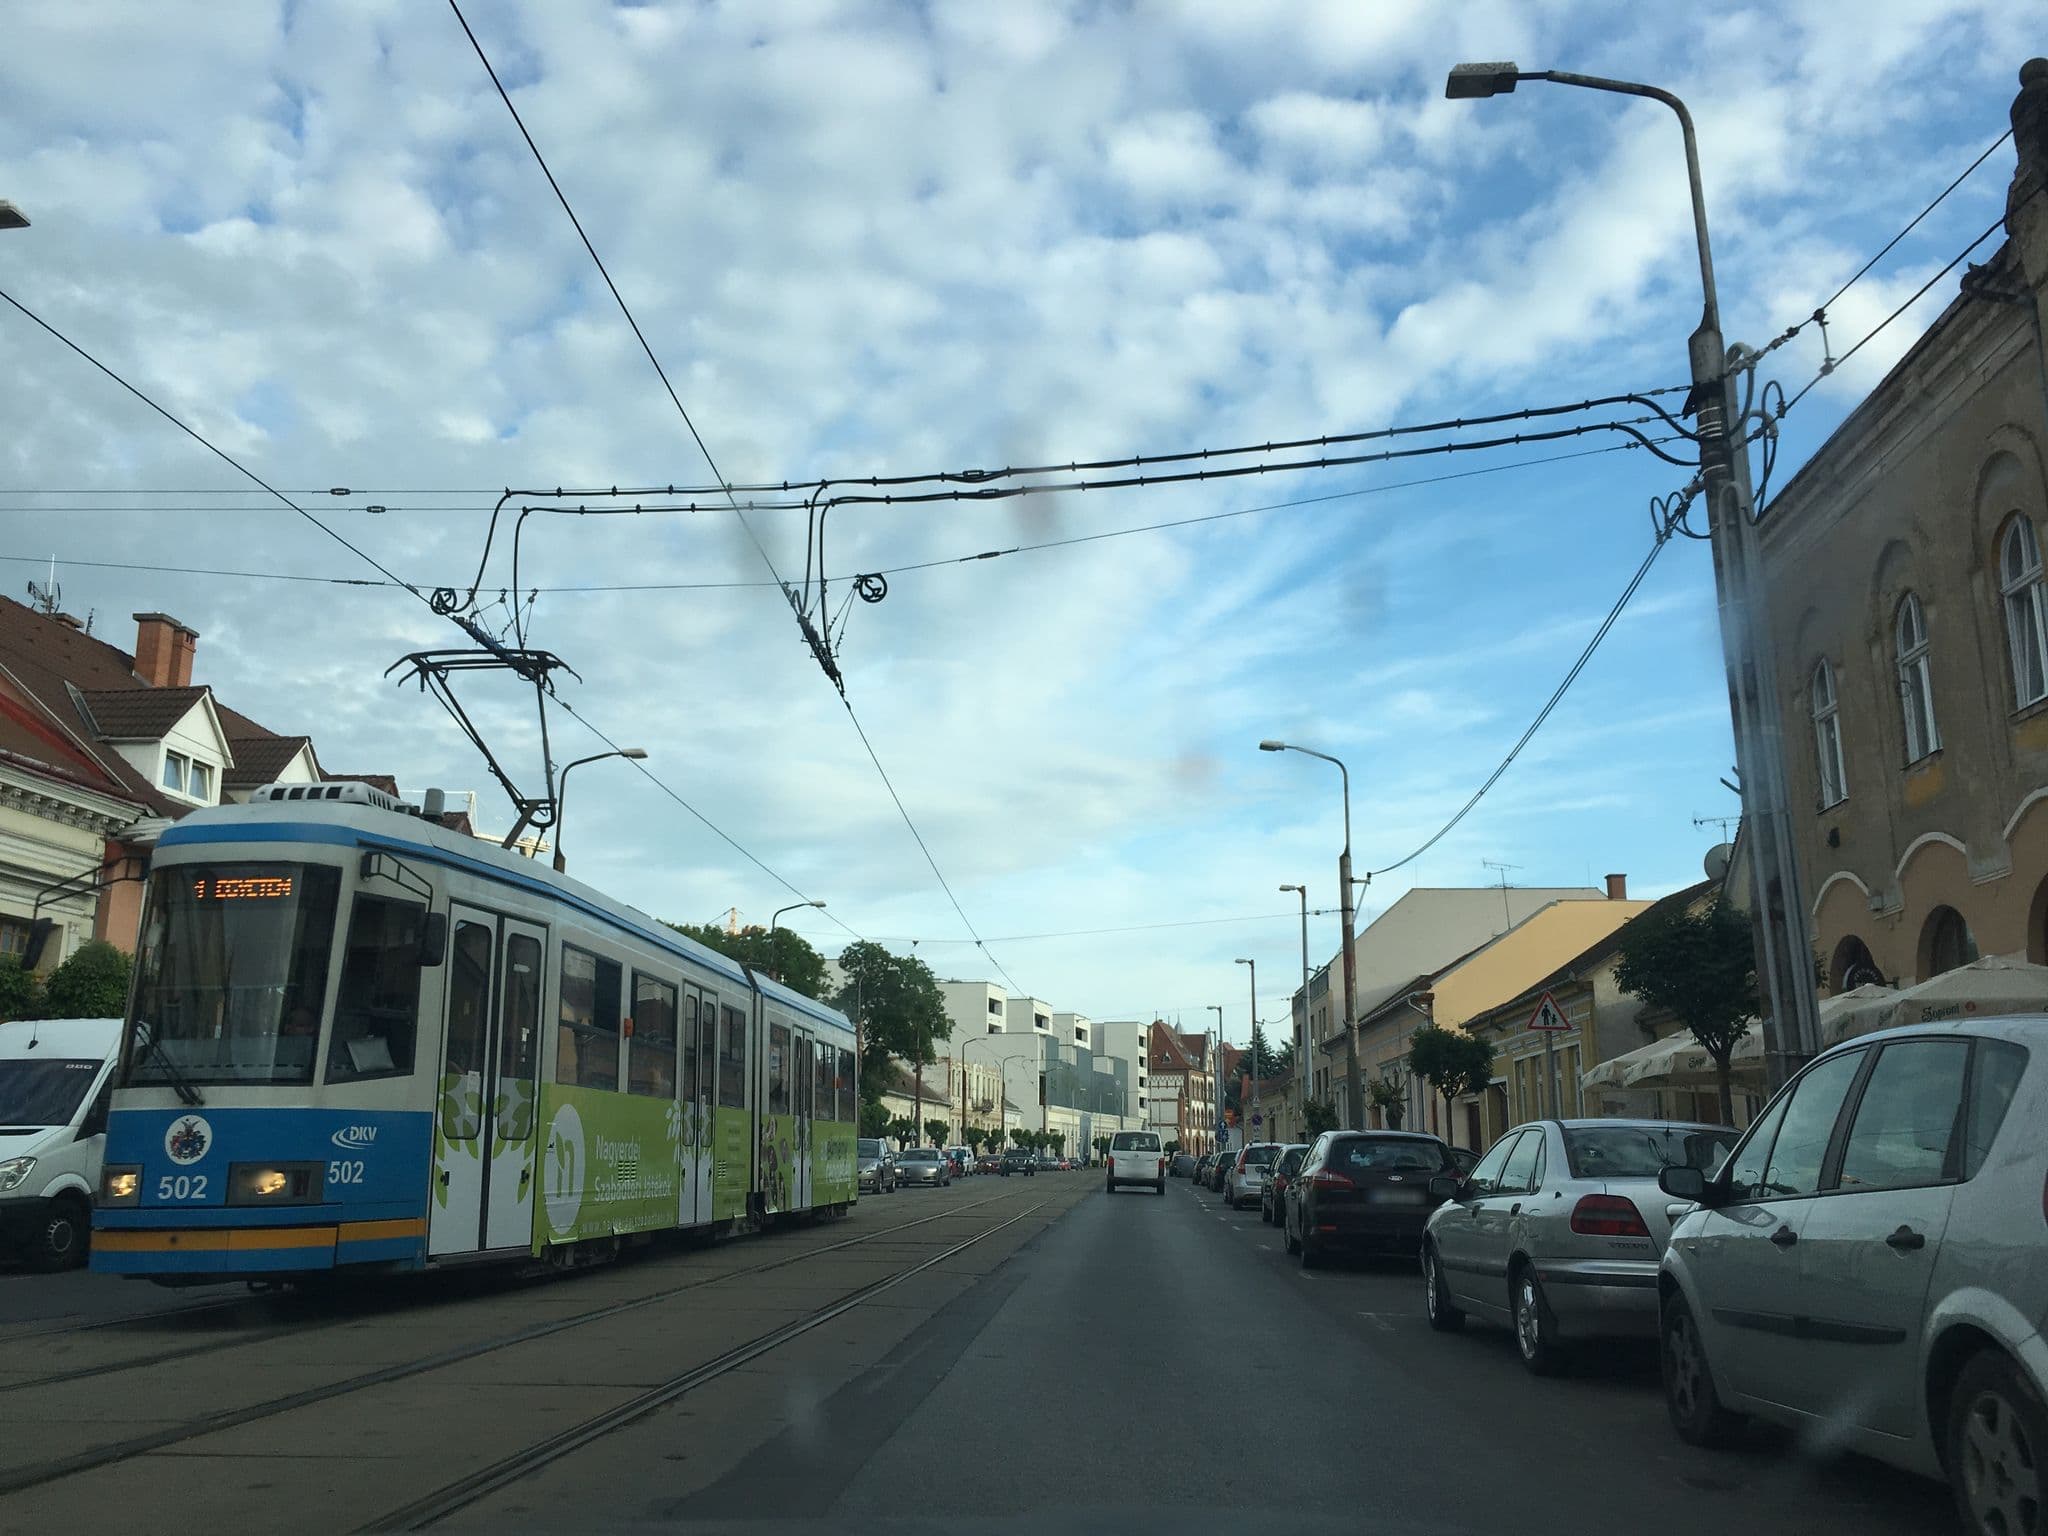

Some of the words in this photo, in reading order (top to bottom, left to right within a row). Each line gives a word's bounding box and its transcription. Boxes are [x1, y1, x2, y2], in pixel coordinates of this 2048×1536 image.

[349, 1126, 377, 1142] DKV
[328, 1160, 364, 1184] 502
[158, 1175, 208, 1200] 502
